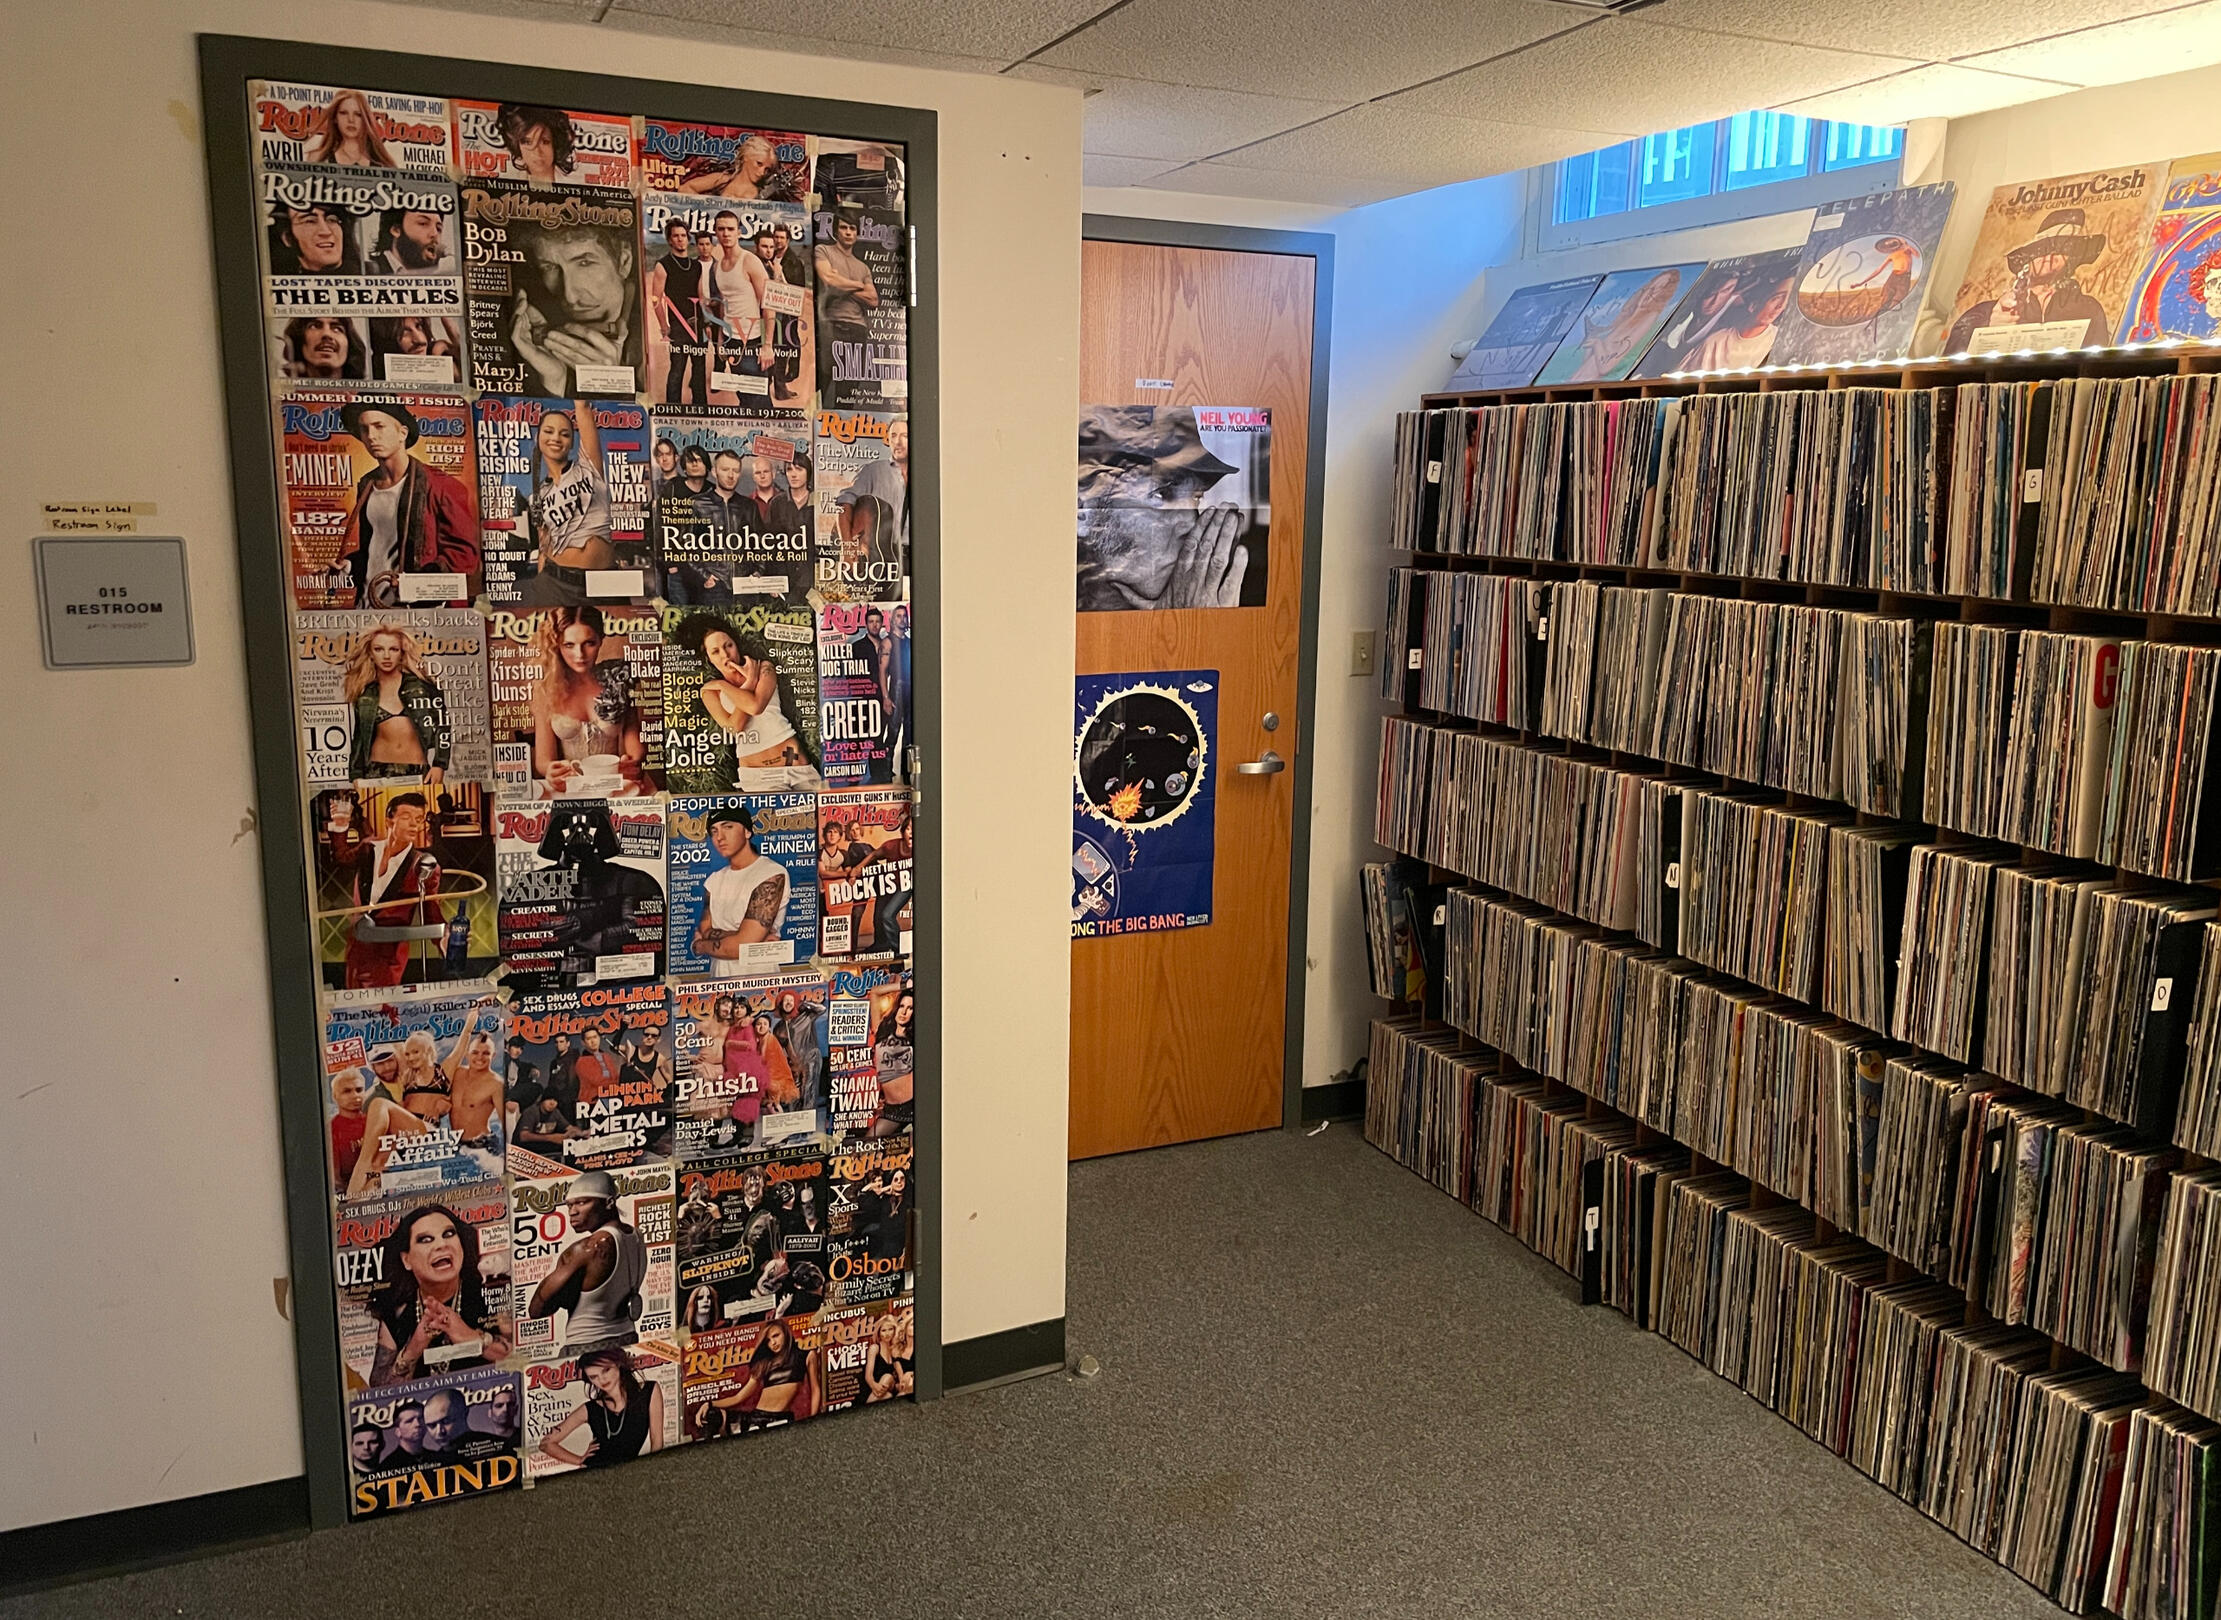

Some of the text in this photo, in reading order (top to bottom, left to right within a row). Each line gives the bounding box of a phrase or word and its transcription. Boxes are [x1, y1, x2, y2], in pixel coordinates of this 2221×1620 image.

[465, 151, 510, 172] HOT
[642, 159, 690, 175] Ultra-
[644, 173, 680, 189] Cool
[2009, 169, 2146, 207] Johnny Cash
[2103, 189, 2142, 201] BALLAD
[465, 241, 526, 265] Dylan
[312, 279, 361, 287] TAPES
[365, 279, 456, 287] DISCOVERED!
[272, 289, 459, 304] THE BEATLES
[470, 301, 500, 311] Britney
[470, 309, 499, 318] Spears
[471, 319, 494, 329] Björk
[471, 331, 496, 339] Creed
[474, 362, 528, 380] Mary J.
[475, 378, 524, 392] BLIGE
[280, 392, 463, 406] SUMMER DOUBLE ISSUE
[652, 405, 682, 415] JOHN
[686, 406, 704, 415] LEE
[708, 407, 755, 417] HOOKER:
[1201, 412, 1267, 424] NEIL YOUNG
[477, 421, 531, 439] ALICIA
[1228, 425, 1267, 433] PASSIONATE?
[478, 439, 519, 456] KEYS
[842, 445, 879, 459] White
[479, 457, 530, 473] RISING
[607, 453, 627, 465] THE
[818, 458, 860, 474] Stripes
[285, 454, 352, 487] EMINEM
[609, 466, 645, 483] NEW
[481, 487, 517, 497] ARTIST
[560, 478, 594, 499] YORK
[610, 484, 648, 502] WAR
[661, 498, 695, 506] In Order
[293, 512, 348, 524] 187
[483, 508, 509, 519] YEAR
[549, 500, 584, 527] CITY
[662, 516, 711, 525] Themselves
[106, 521, 130, 532] Sign
[610, 518, 644, 530] JIHAD
[662, 525, 807, 550] Radiohead
[485, 552, 526, 561] NO DOUBT
[665, 552, 807, 563] Had to Destroy Rock & Roll
[486, 572, 516, 581] ADAMS
[818, 558, 899, 581] BRUCE
[297, 576, 354, 589] NORAH JONES
[99, 588, 127, 597] 015
[487, 592, 522, 601] KRAVITZ
[66, 603, 162, 614] RESTROOM
[490, 648, 540, 659] Spider-Man's
[623, 645, 660, 662] Robert
[821, 644, 853, 660] KILLER
[490, 663, 543, 680] Kirsten
[631, 662, 660, 678] Blake
[822, 660, 870, 676] DOG TRIAL
[663, 673, 703, 685] Blood
[491, 682, 533, 701] Dunst
[664, 702, 691, 714] Sex
[664, 715, 708, 731] Magic
[822, 701, 881, 740] CREED
[304, 726, 347, 751] 10
[666, 728, 759, 751] Angelina
[306, 753, 348, 763] Years
[666, 748, 715, 768] Jolie
[308, 765, 348, 778] After
[670, 794, 815, 812] PEOPLE OF THE YEAR
[761, 841, 815, 854] EMINEM
[671, 850, 711, 864] 2002
[786, 860, 794, 868] JA
[501, 869, 578, 890] DARTH
[1669, 867, 1677, 882] N
[500, 885, 574, 903] VADER
[829, 874, 896, 905] ROCK IS
[511, 906, 557, 915] CREATOR
[1098, 919, 1122, 934] THE
[1126, 916, 1147, 931] BIG
[1150, 913, 1184, 928] BANG
[512, 931, 554, 940] SECRETS
[512, 951, 564, 960] OBSESSION
[678, 975, 822, 994] PHIL SPECTOR MURDER MYSTERY
[581, 986, 665, 1006] COLLEGE
[523, 1002, 581, 1013] AND ESSAYS
[626, 1002, 662, 1011] SPECIAL
[831, 1015, 866, 1025] READERS
[831, 1025, 865, 1035] & CRITICS
[675, 1072, 758, 1101] Phish
[831, 1076, 878, 1093] SHANIA
[576, 1099, 623, 1119] RAP
[829, 1091, 879, 1113] TWAIN
[590, 1112, 666, 1135] METAL
[378, 1129, 464, 1152] Family
[384, 1148, 460, 1166] Affair
[830, 1184, 851, 1205] X
[639, 1211, 671, 1223] ROCK
[1588, 1213, 1595, 1226] T
[513, 1212, 566, 1246] 50
[514, 1242, 562, 1260] CENT
[337, 1247, 384, 1286] OZZY
[682, 1255, 749, 1280] SLIPKNOT
[824, 1307, 866, 1322] INCUBUS
[640, 1322, 671, 1332] BOYS
[828, 1346, 867, 1371] ME!
[528, 1400, 571, 1414] Brains
[357, 1456, 518, 1513] STAIND
